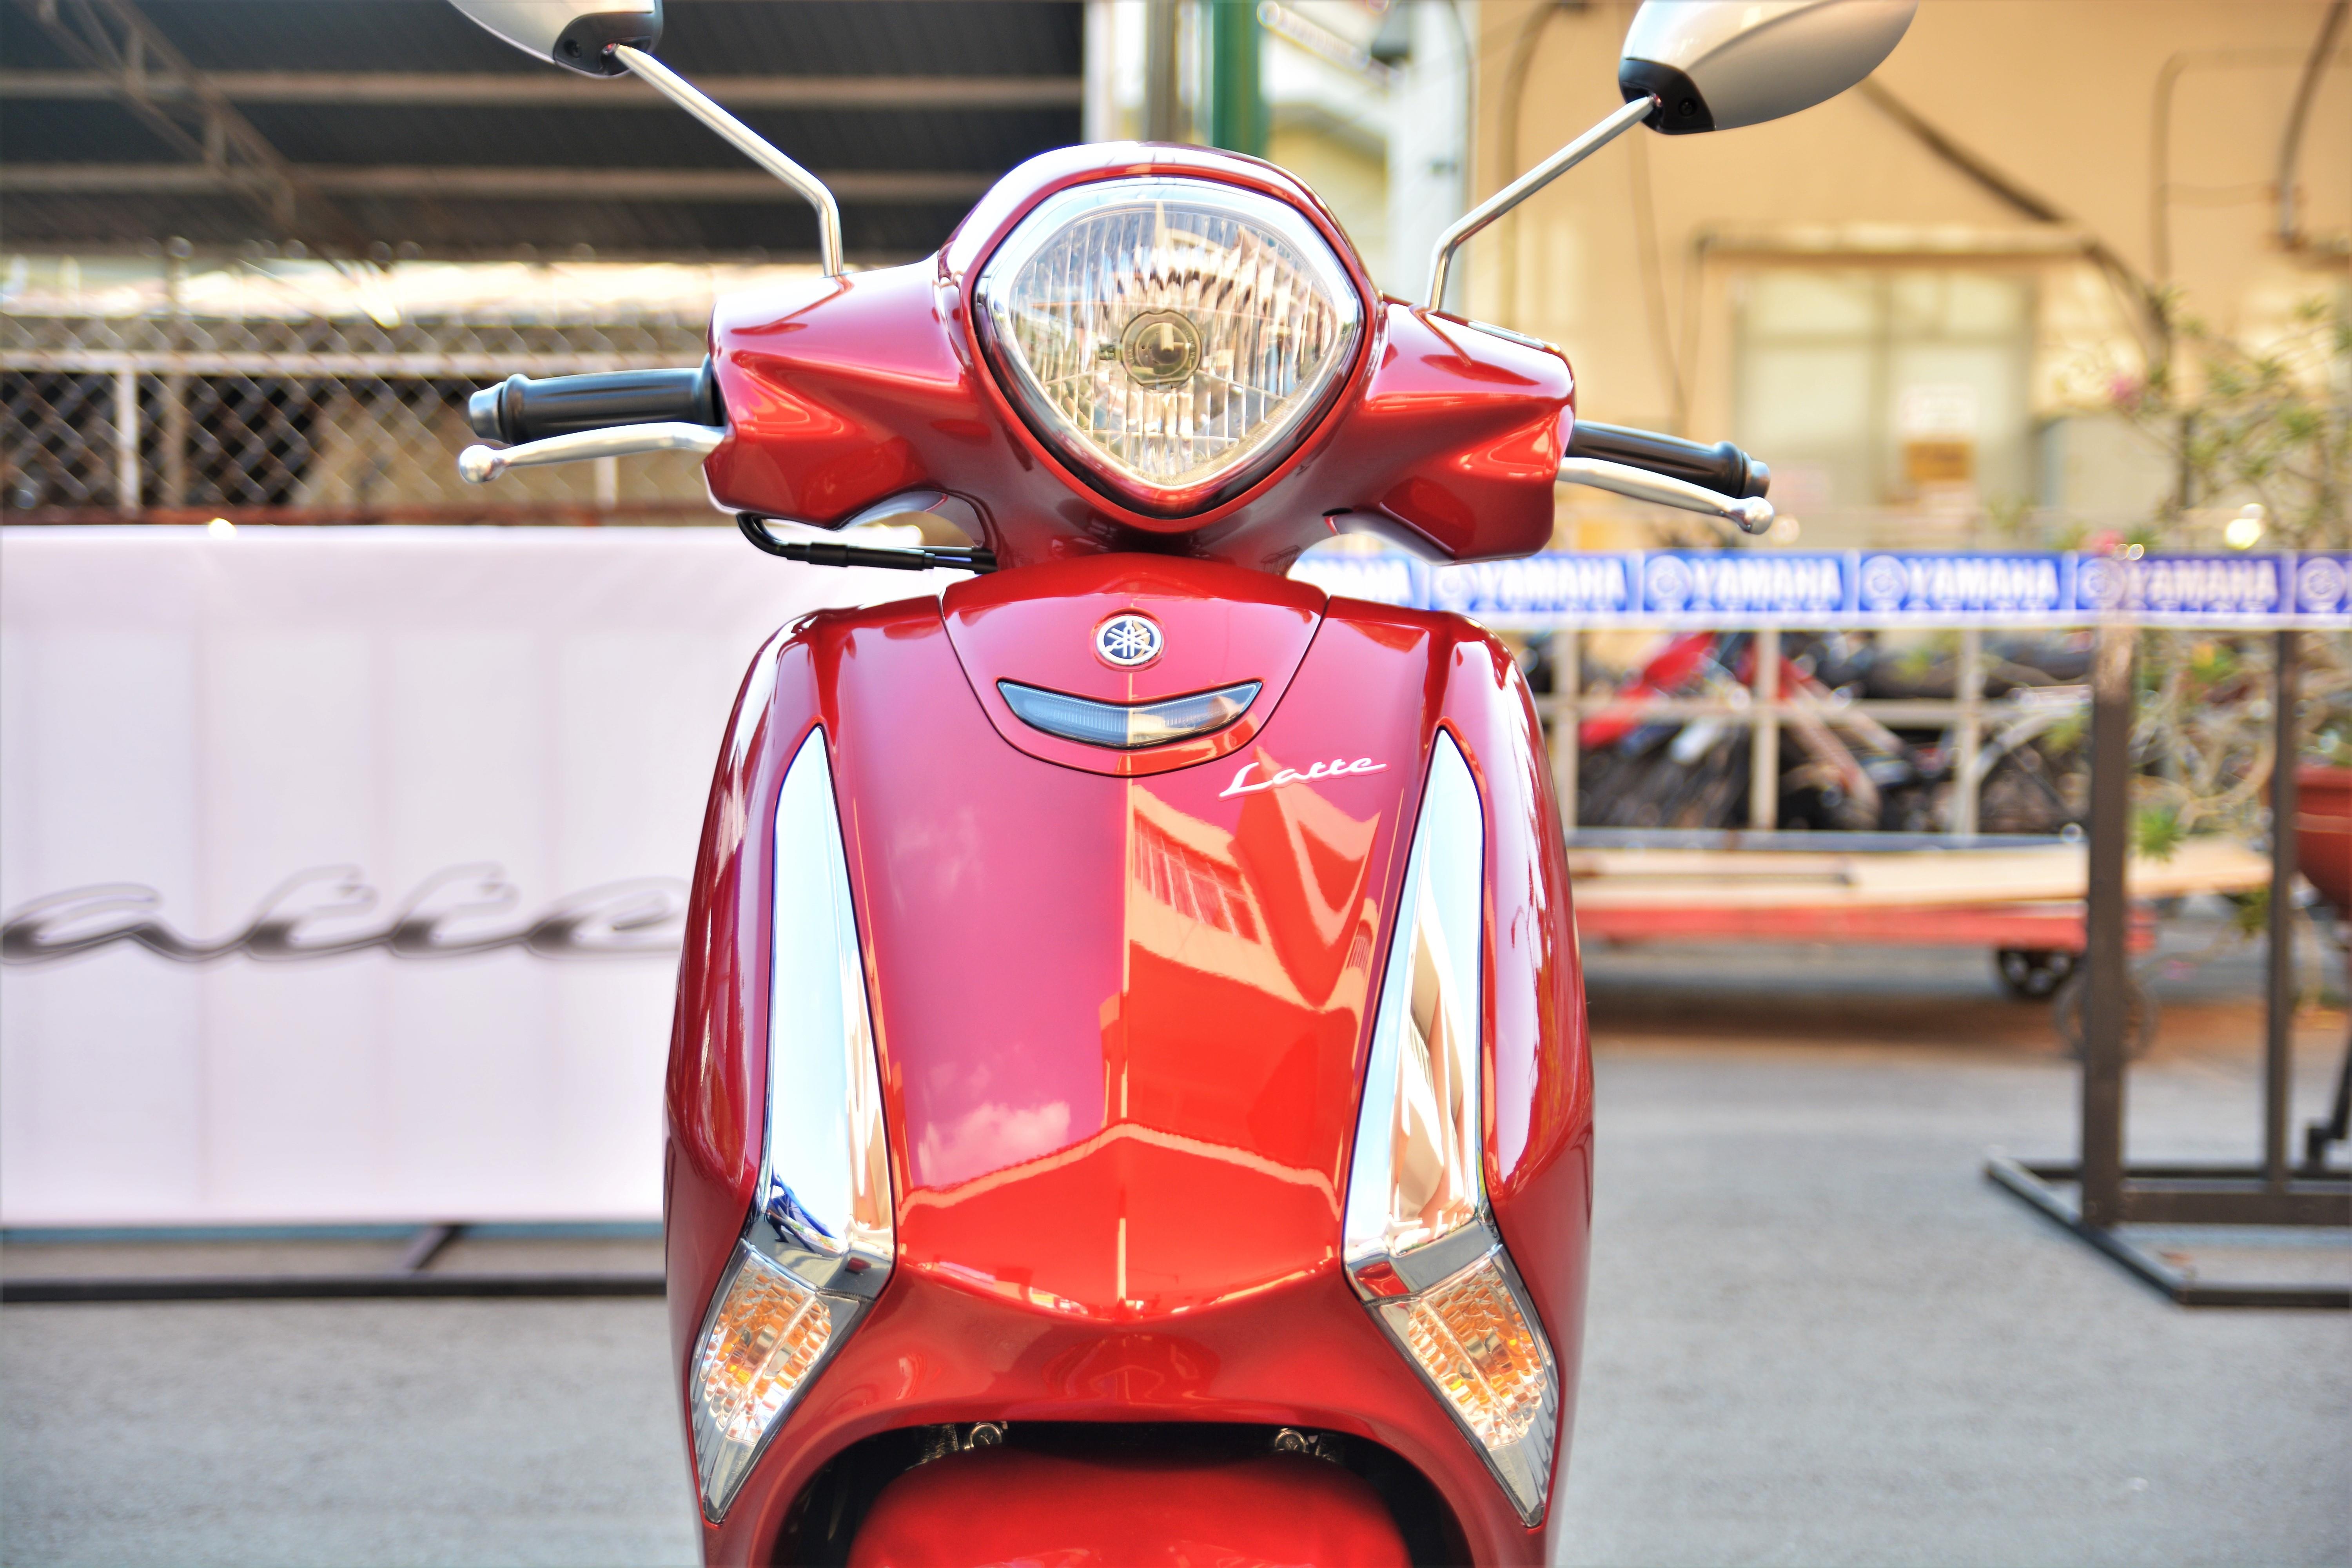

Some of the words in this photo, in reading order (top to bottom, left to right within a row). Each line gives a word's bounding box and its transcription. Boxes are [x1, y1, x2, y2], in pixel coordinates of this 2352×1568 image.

[1689, 557, 1842, 607] YAMAHA
[1905, 557, 2059, 606] YAMAHA
[2125, 558, 2278, 608] YAMAHA
[1219, 757, 1387, 797] Latte
